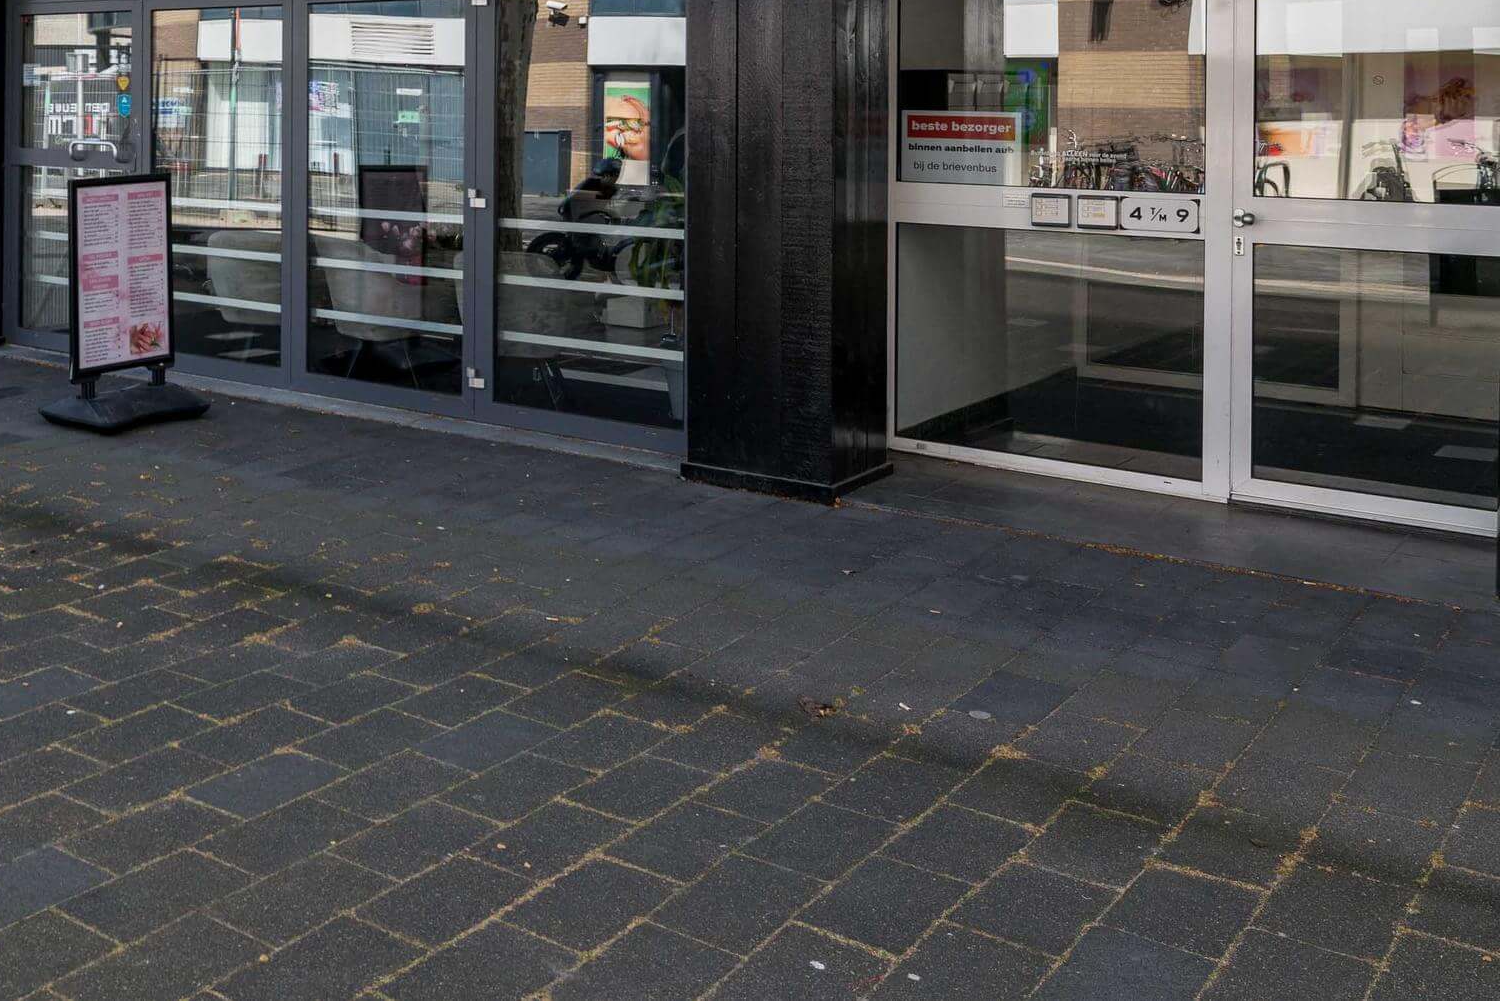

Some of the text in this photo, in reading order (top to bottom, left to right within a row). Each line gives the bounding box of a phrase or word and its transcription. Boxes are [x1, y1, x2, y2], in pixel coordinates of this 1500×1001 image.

[911, 120, 1012, 135] beste bezorger
[908, 143, 1014, 154] binnen aanbellen aub
[913, 160, 997, 173] bij de brievenbus
[1129, 206, 1142, 221] 4
[1176, 208, 1190, 223] 9
